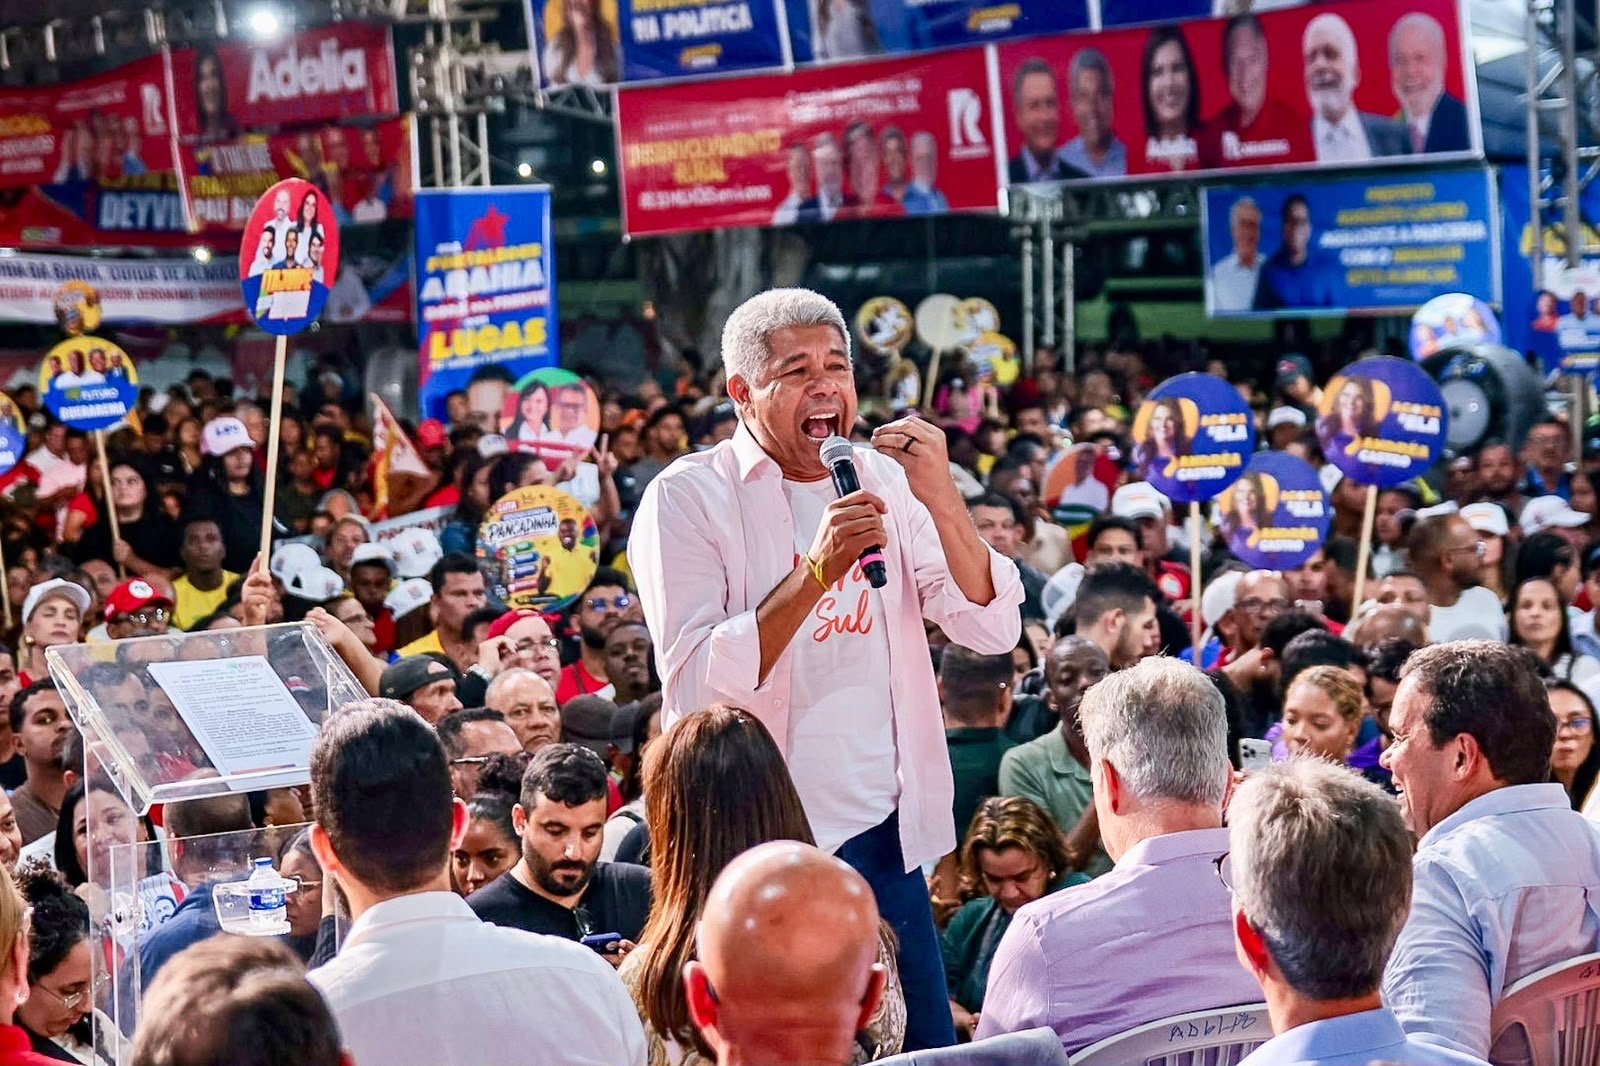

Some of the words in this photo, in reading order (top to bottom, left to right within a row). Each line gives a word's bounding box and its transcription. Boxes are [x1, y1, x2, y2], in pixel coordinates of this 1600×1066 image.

[247, 38, 366, 103] Adelia
[430, 317, 547, 359] LUCAS
[813, 589, 873, 642] Sul
